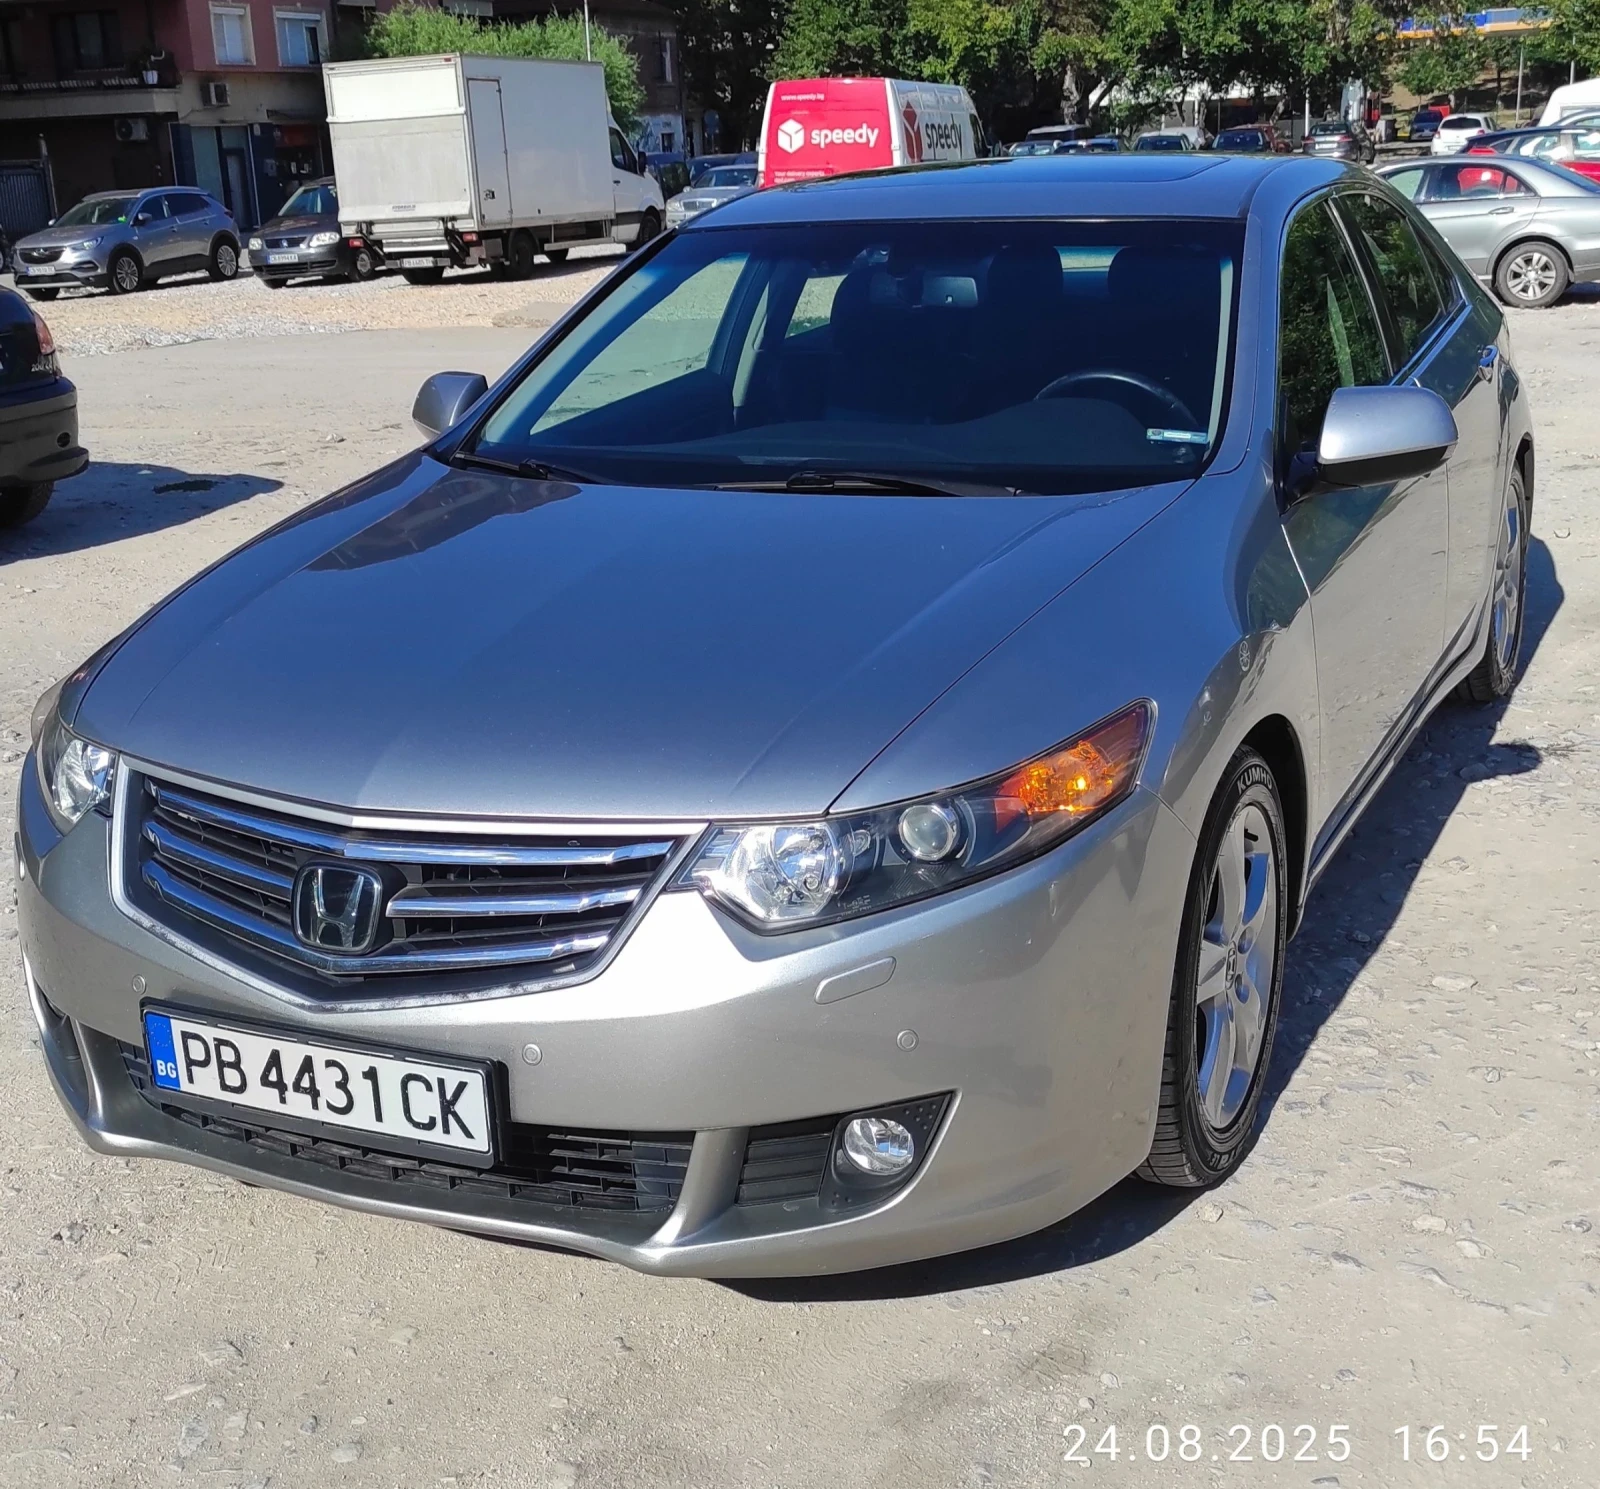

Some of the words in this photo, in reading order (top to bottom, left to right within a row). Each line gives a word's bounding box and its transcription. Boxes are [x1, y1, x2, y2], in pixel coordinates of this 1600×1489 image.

[811, 123, 879, 149] speedy
[925, 114, 962, 160] speedy
[1237, 767, 1273, 795] KUMHO
[157, 1059, 177, 1079] BG
[180, 1030, 248, 1095] PB
[260, 1048, 384, 1123] 4431
[400, 1072, 476, 1139] CK
